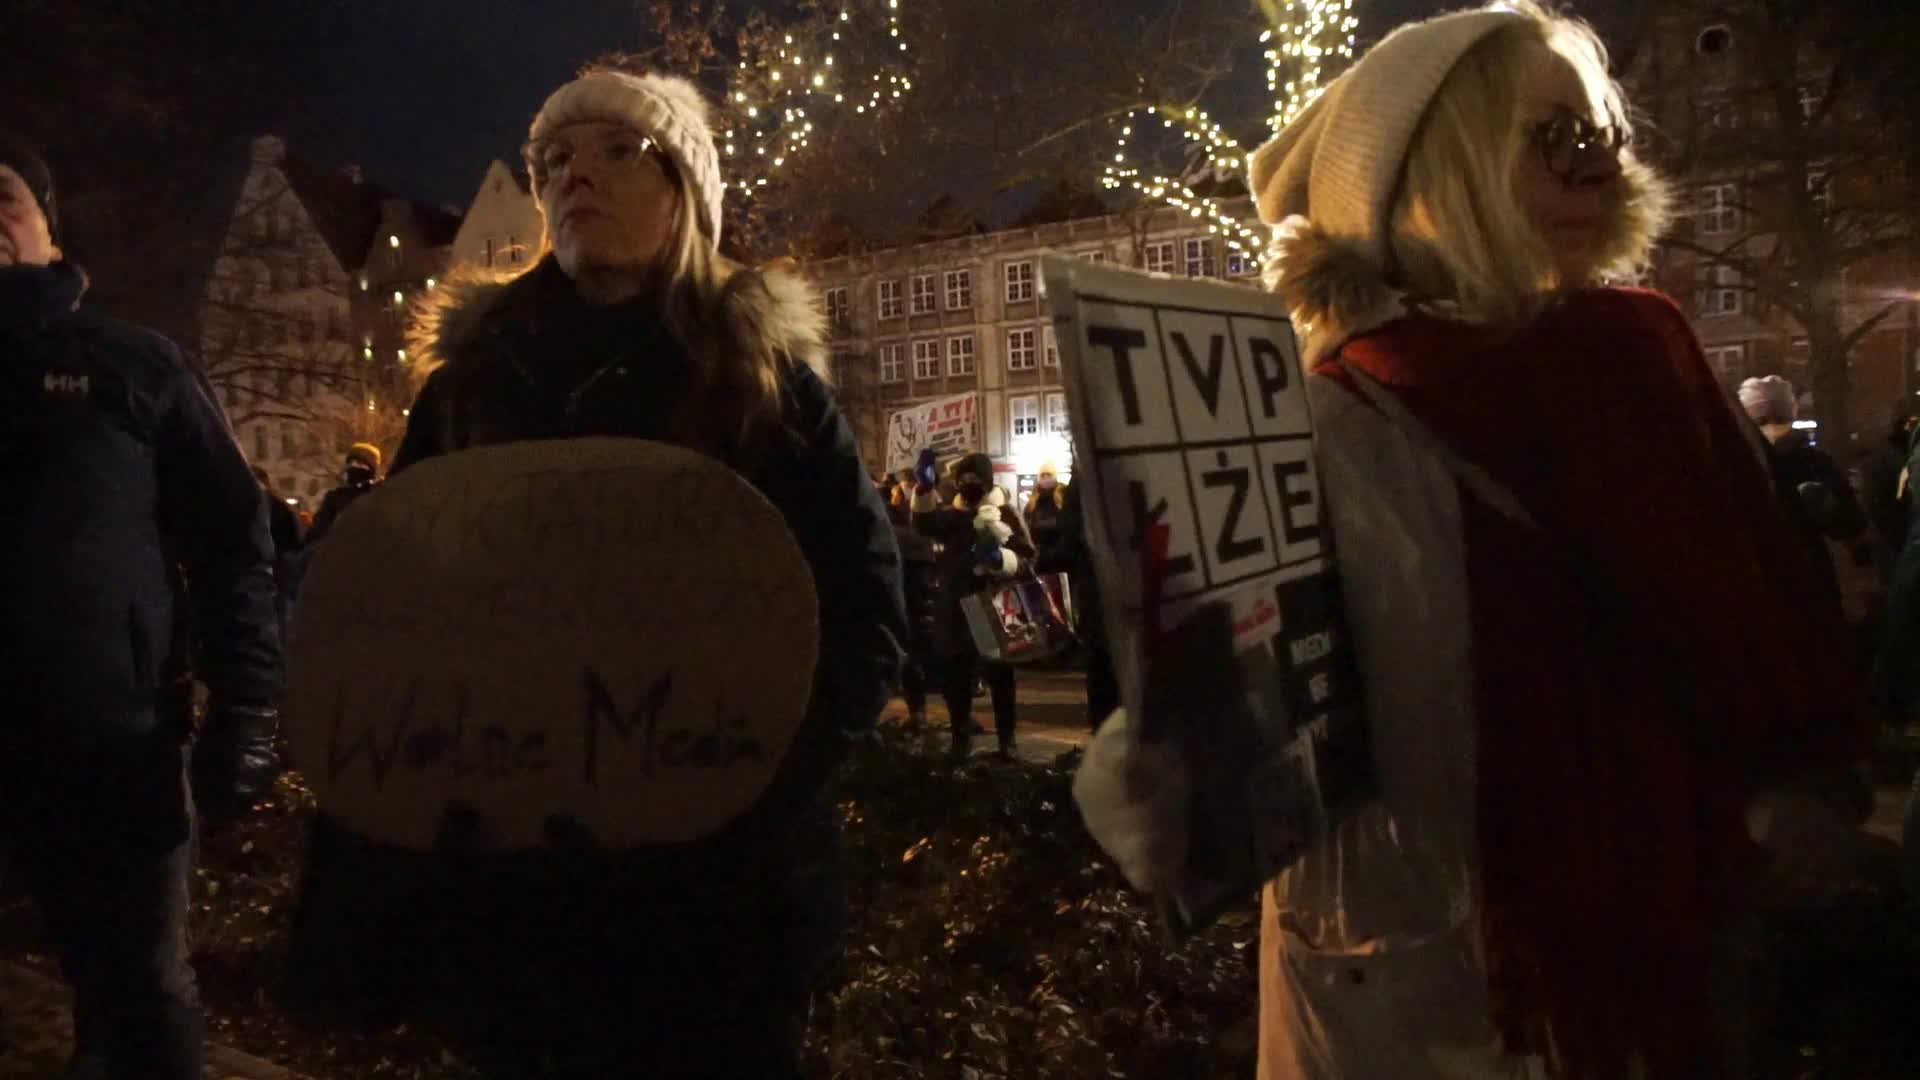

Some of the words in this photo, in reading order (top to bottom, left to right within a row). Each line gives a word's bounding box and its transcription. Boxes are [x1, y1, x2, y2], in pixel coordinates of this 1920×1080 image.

[1088, 326, 1288, 424] TVP
[1129, 452, 1322, 574] ŁŻE
[326, 672, 549, 791] Wolne
[580, 665, 764, 790] Media
